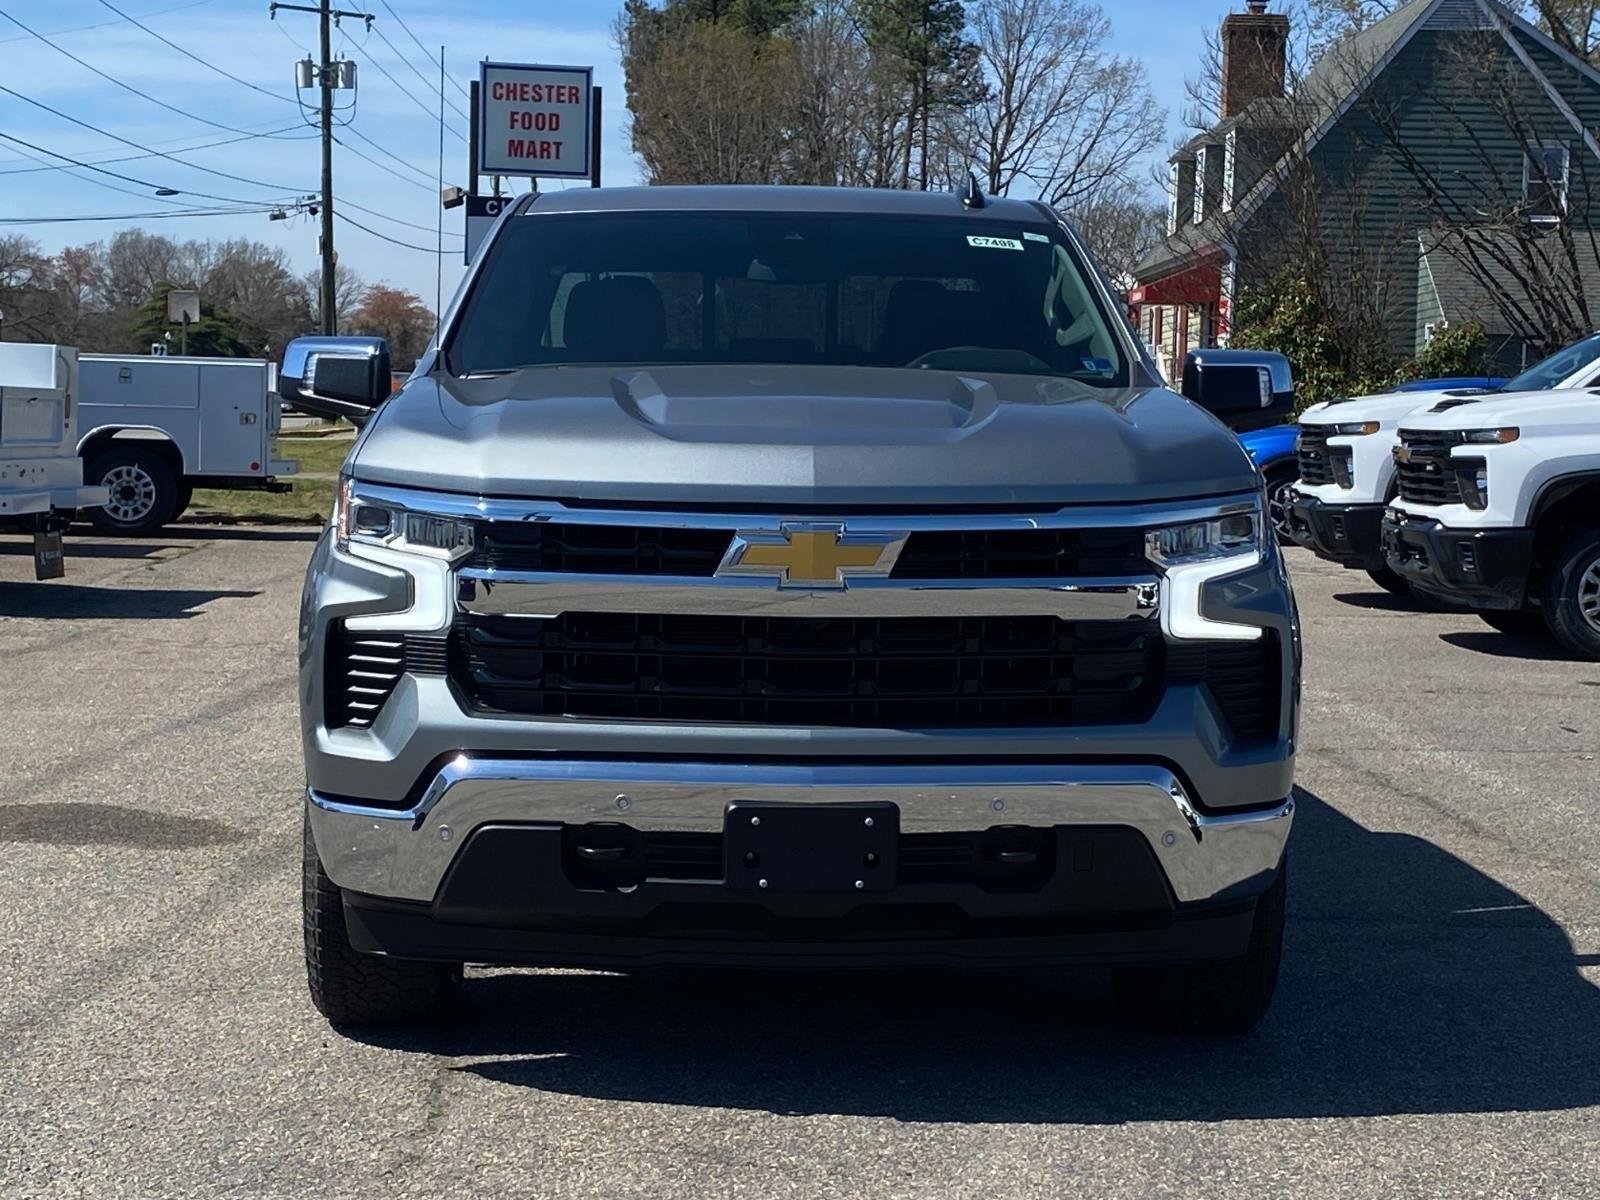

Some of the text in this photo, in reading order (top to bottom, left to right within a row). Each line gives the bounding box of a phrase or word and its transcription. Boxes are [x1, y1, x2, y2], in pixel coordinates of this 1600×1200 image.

[492, 82, 580, 104] CHESTER
[509, 111, 560, 131] FOOD
[508, 139, 563, 160] MART
